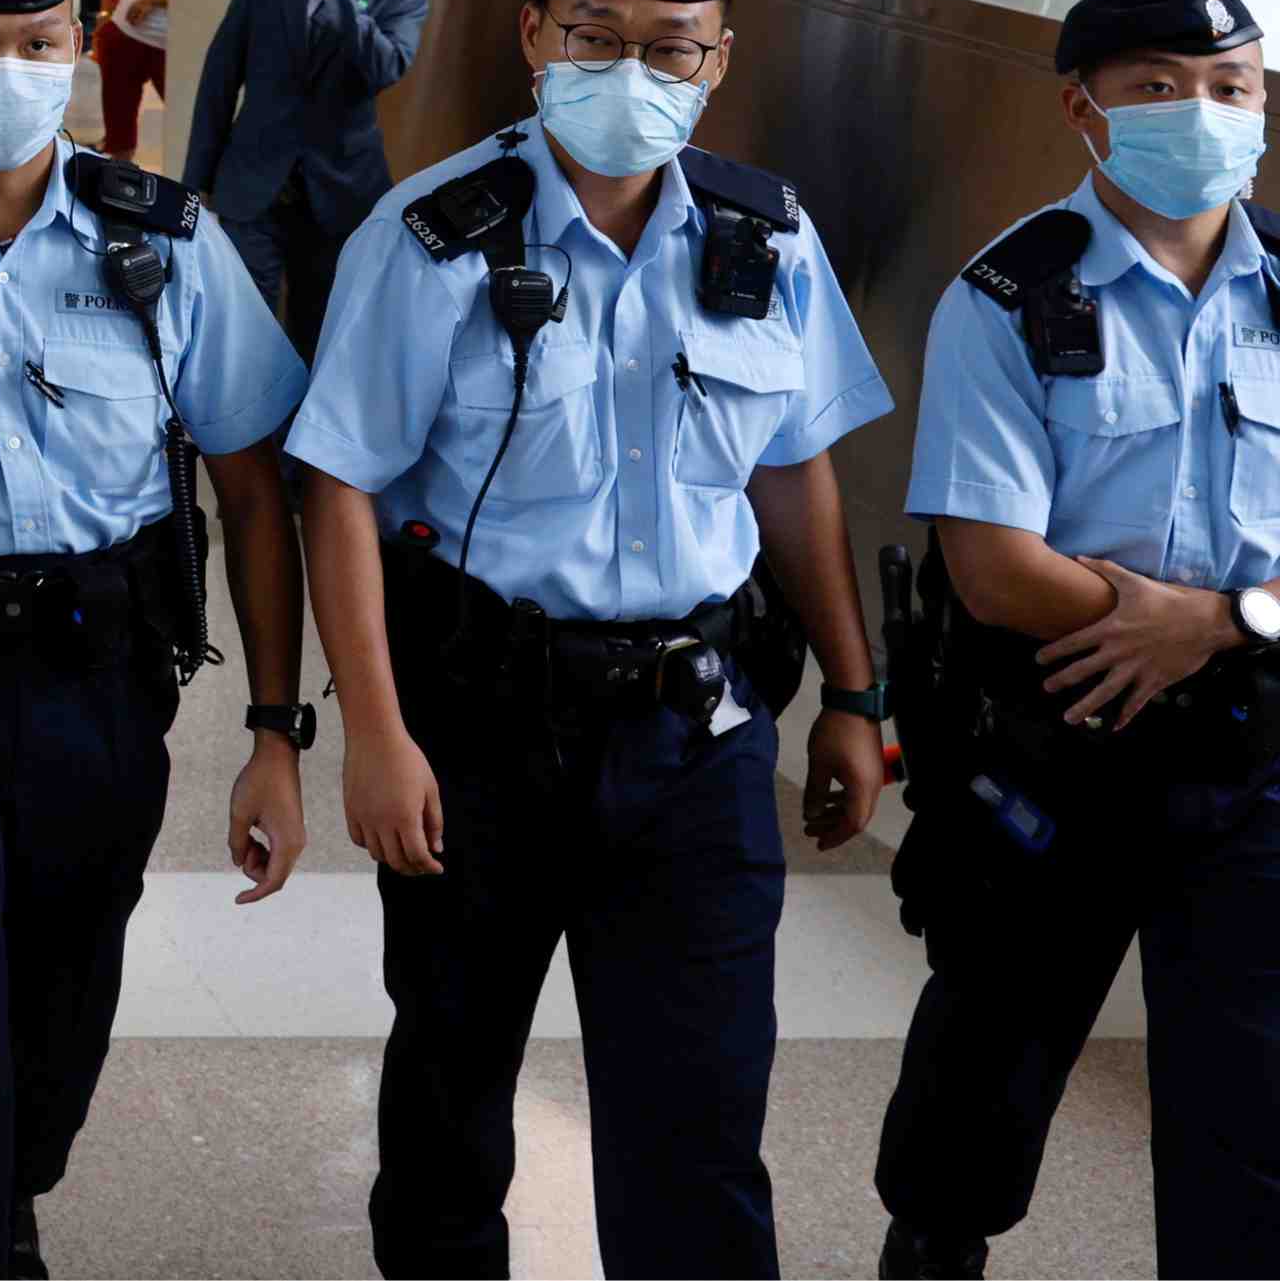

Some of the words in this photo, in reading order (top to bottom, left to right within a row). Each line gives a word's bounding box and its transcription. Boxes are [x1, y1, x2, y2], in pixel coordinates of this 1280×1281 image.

[180, 191, 201, 231] 26746
[781, 184, 800, 222] 26287
[405, 211, 446, 251] 26287
[973, 263, 1019, 297] 27472
[64, 292, 81, 308] 警
[1240, 327, 1257, 343] 警
